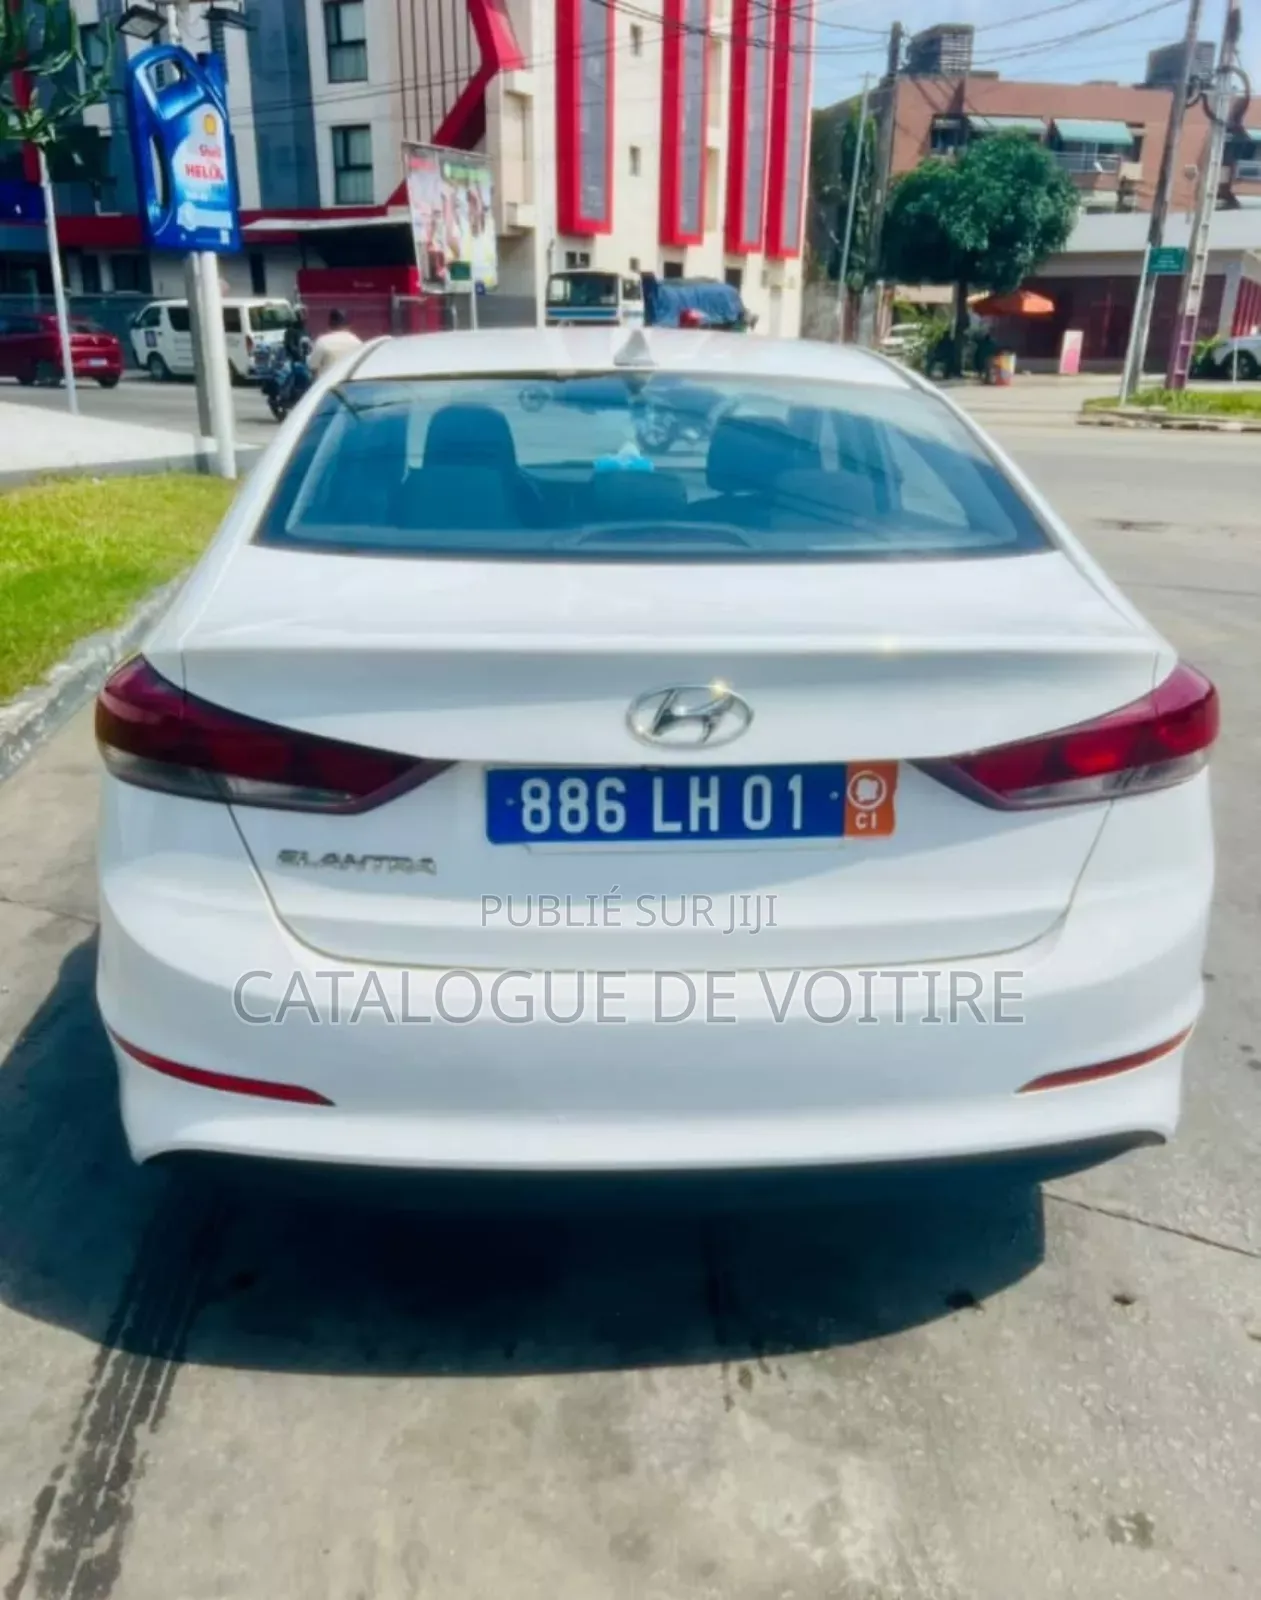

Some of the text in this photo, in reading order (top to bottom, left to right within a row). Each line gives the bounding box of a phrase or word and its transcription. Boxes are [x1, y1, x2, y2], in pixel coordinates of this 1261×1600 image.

[520, 774, 804, 834] 886 LH 01
[854, 812, 878, 830] CI
